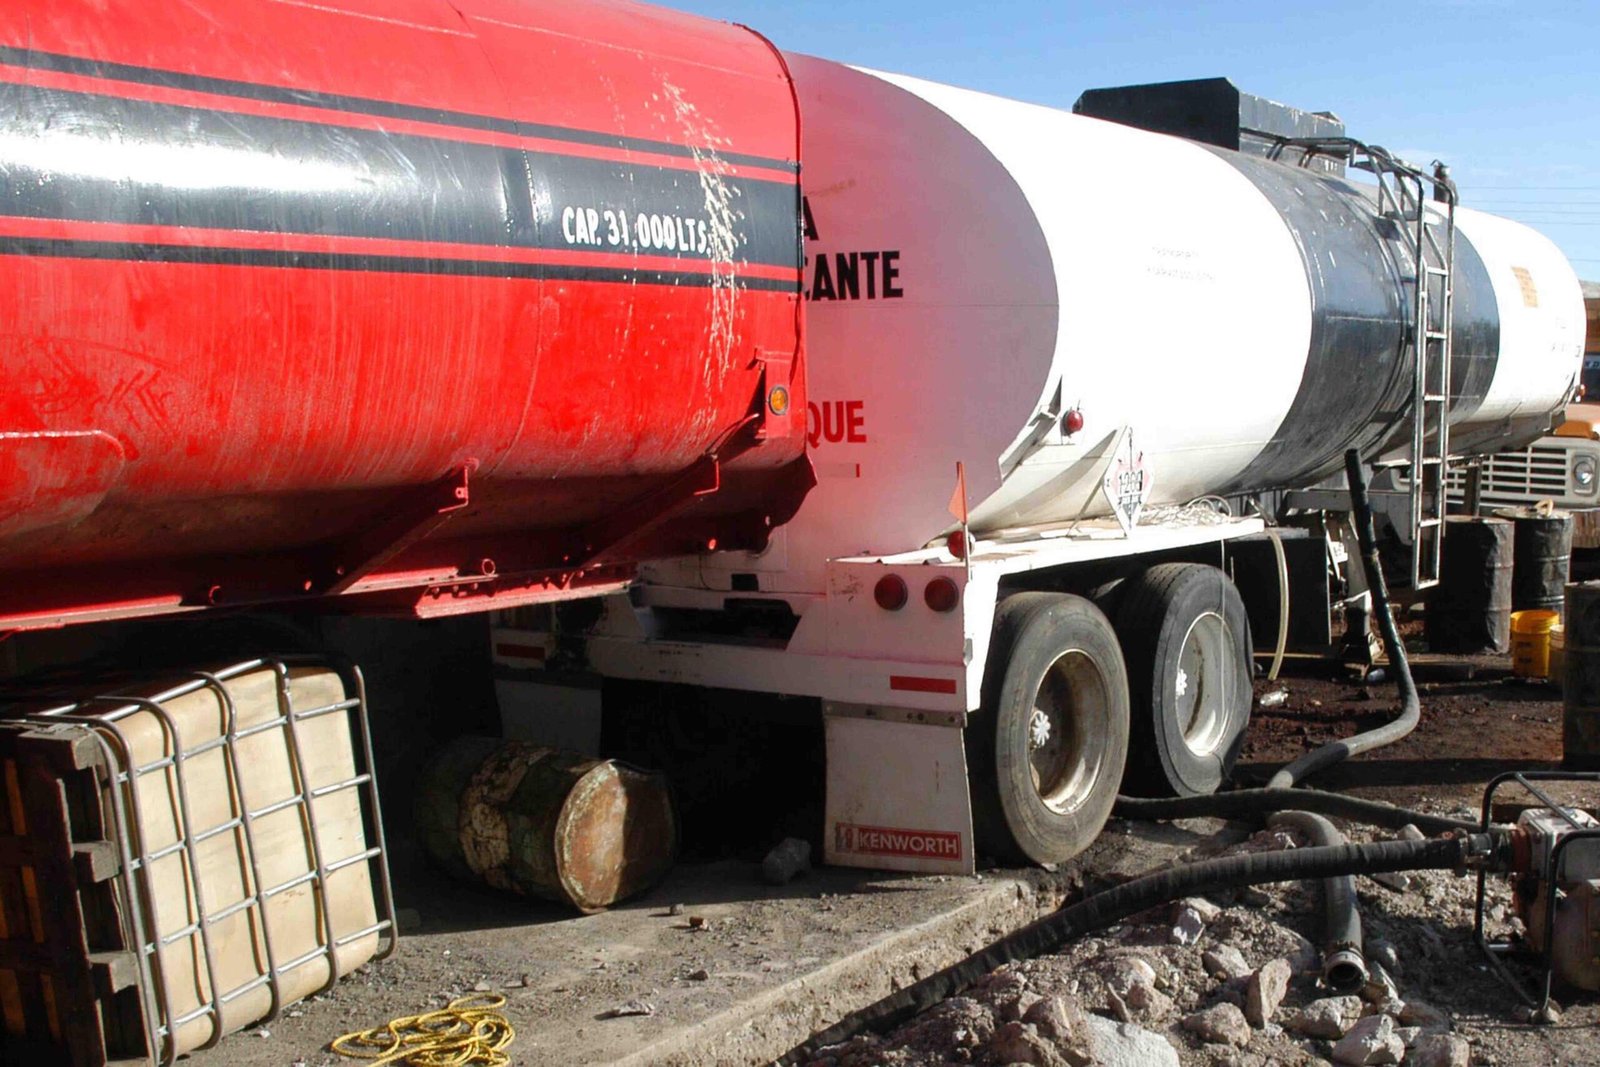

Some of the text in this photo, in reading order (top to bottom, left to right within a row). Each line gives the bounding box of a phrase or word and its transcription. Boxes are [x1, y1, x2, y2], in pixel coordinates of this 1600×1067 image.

[562, 206, 602, 246] CAP.
[804, 250, 904, 302] ANTE
[859, 832, 958, 854] KENWORTH
